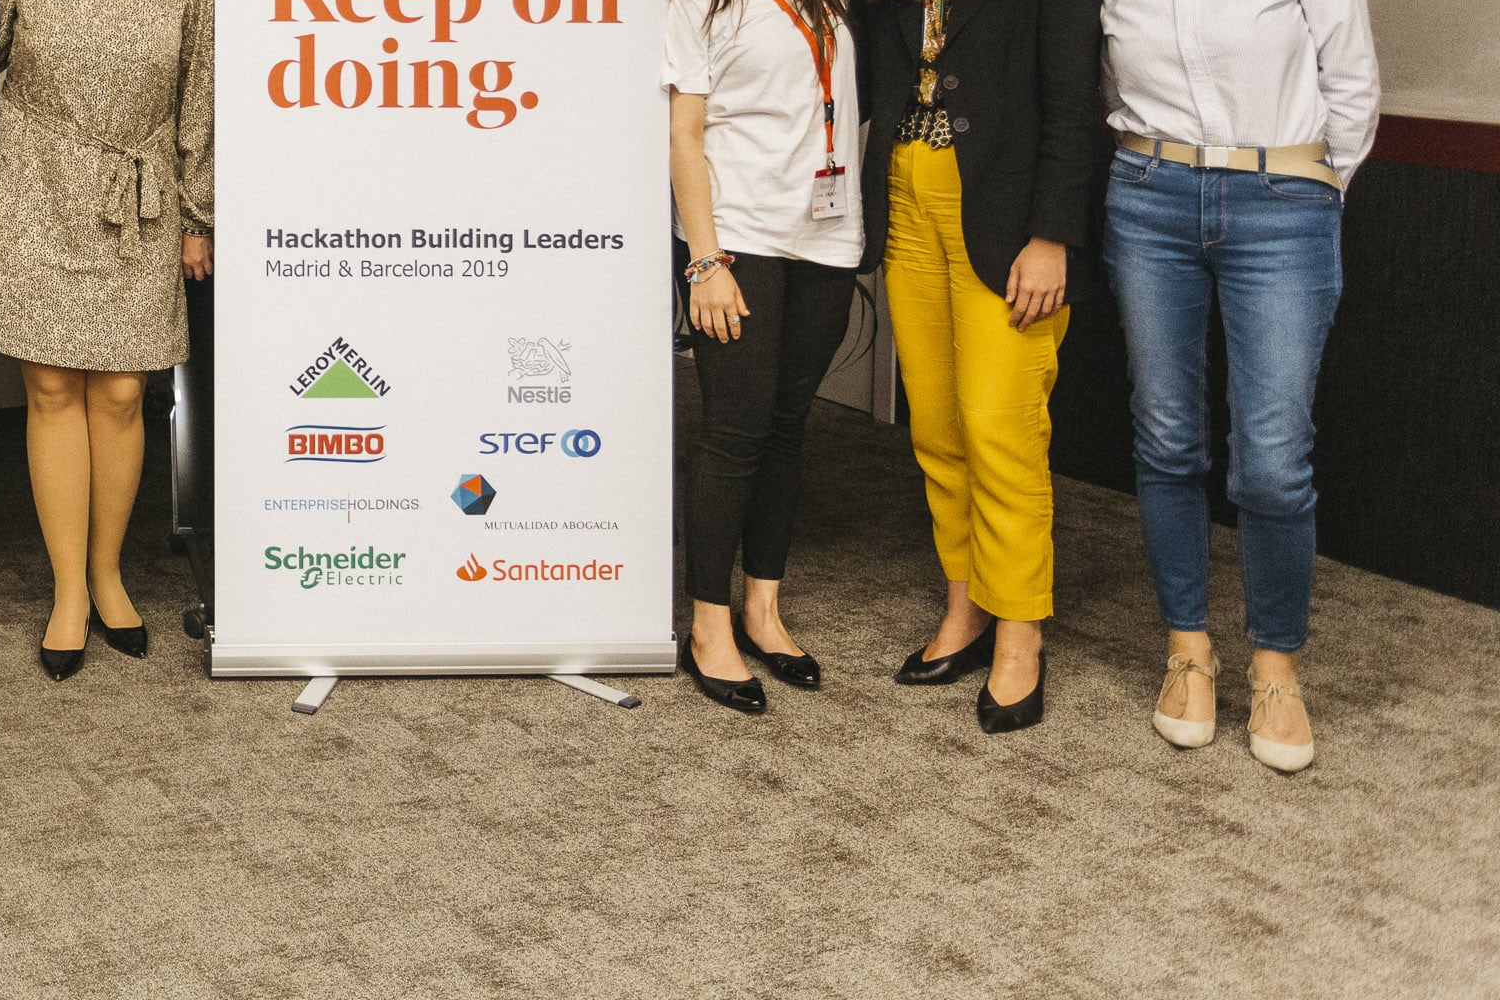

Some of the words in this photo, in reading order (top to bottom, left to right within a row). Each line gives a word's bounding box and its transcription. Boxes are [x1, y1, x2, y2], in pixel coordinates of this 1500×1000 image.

[267, 33, 540, 130] doing.
[266, 228, 402, 249] Hackathon
[411, 228, 514, 254] Building
[523, 228, 625, 250] Leaders
[265, 259, 331, 278] Madrid
[338, 260, 354, 278] &
[360, 259, 454, 278] Barcelona
[461, 260, 509, 278] 2019
[289, 347, 337, 396] LEROY
[331, 336, 391, 397] MERLIN
[288, 433, 384, 455] BIMBO
[484, 521, 559, 530] MUTUALIDAD
[264, 545, 407, 570] Schneider
[326, 571, 403, 586] Electric
[492, 558, 624, 582] Santander
